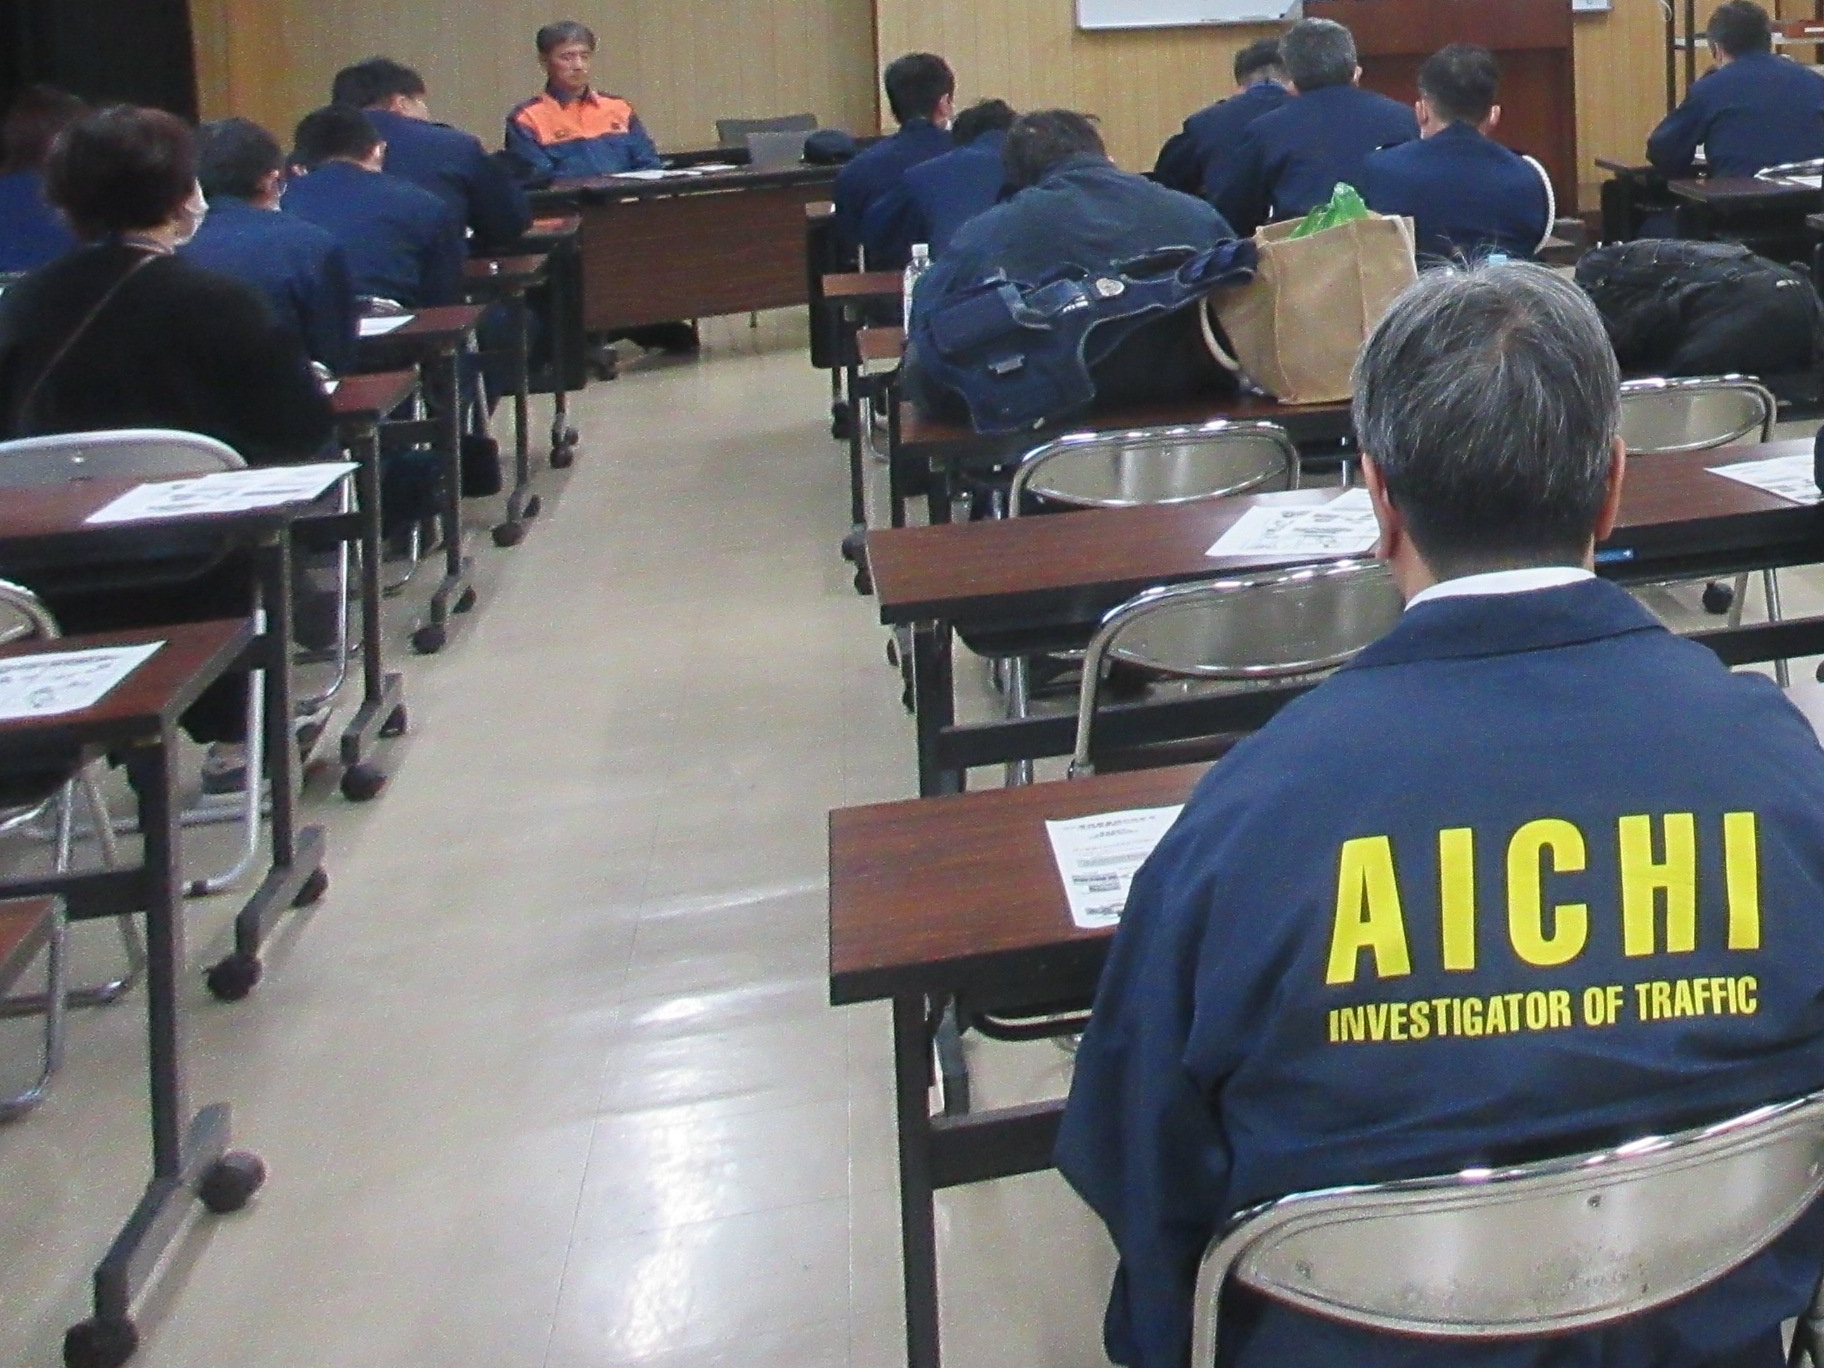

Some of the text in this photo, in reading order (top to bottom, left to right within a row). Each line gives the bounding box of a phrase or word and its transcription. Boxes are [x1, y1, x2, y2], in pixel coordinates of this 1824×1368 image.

[1326, 811, 1760, 985] AICHI
[1328, 975, 1758, 1043] INVESTIGATOR OF TRAFFIC
